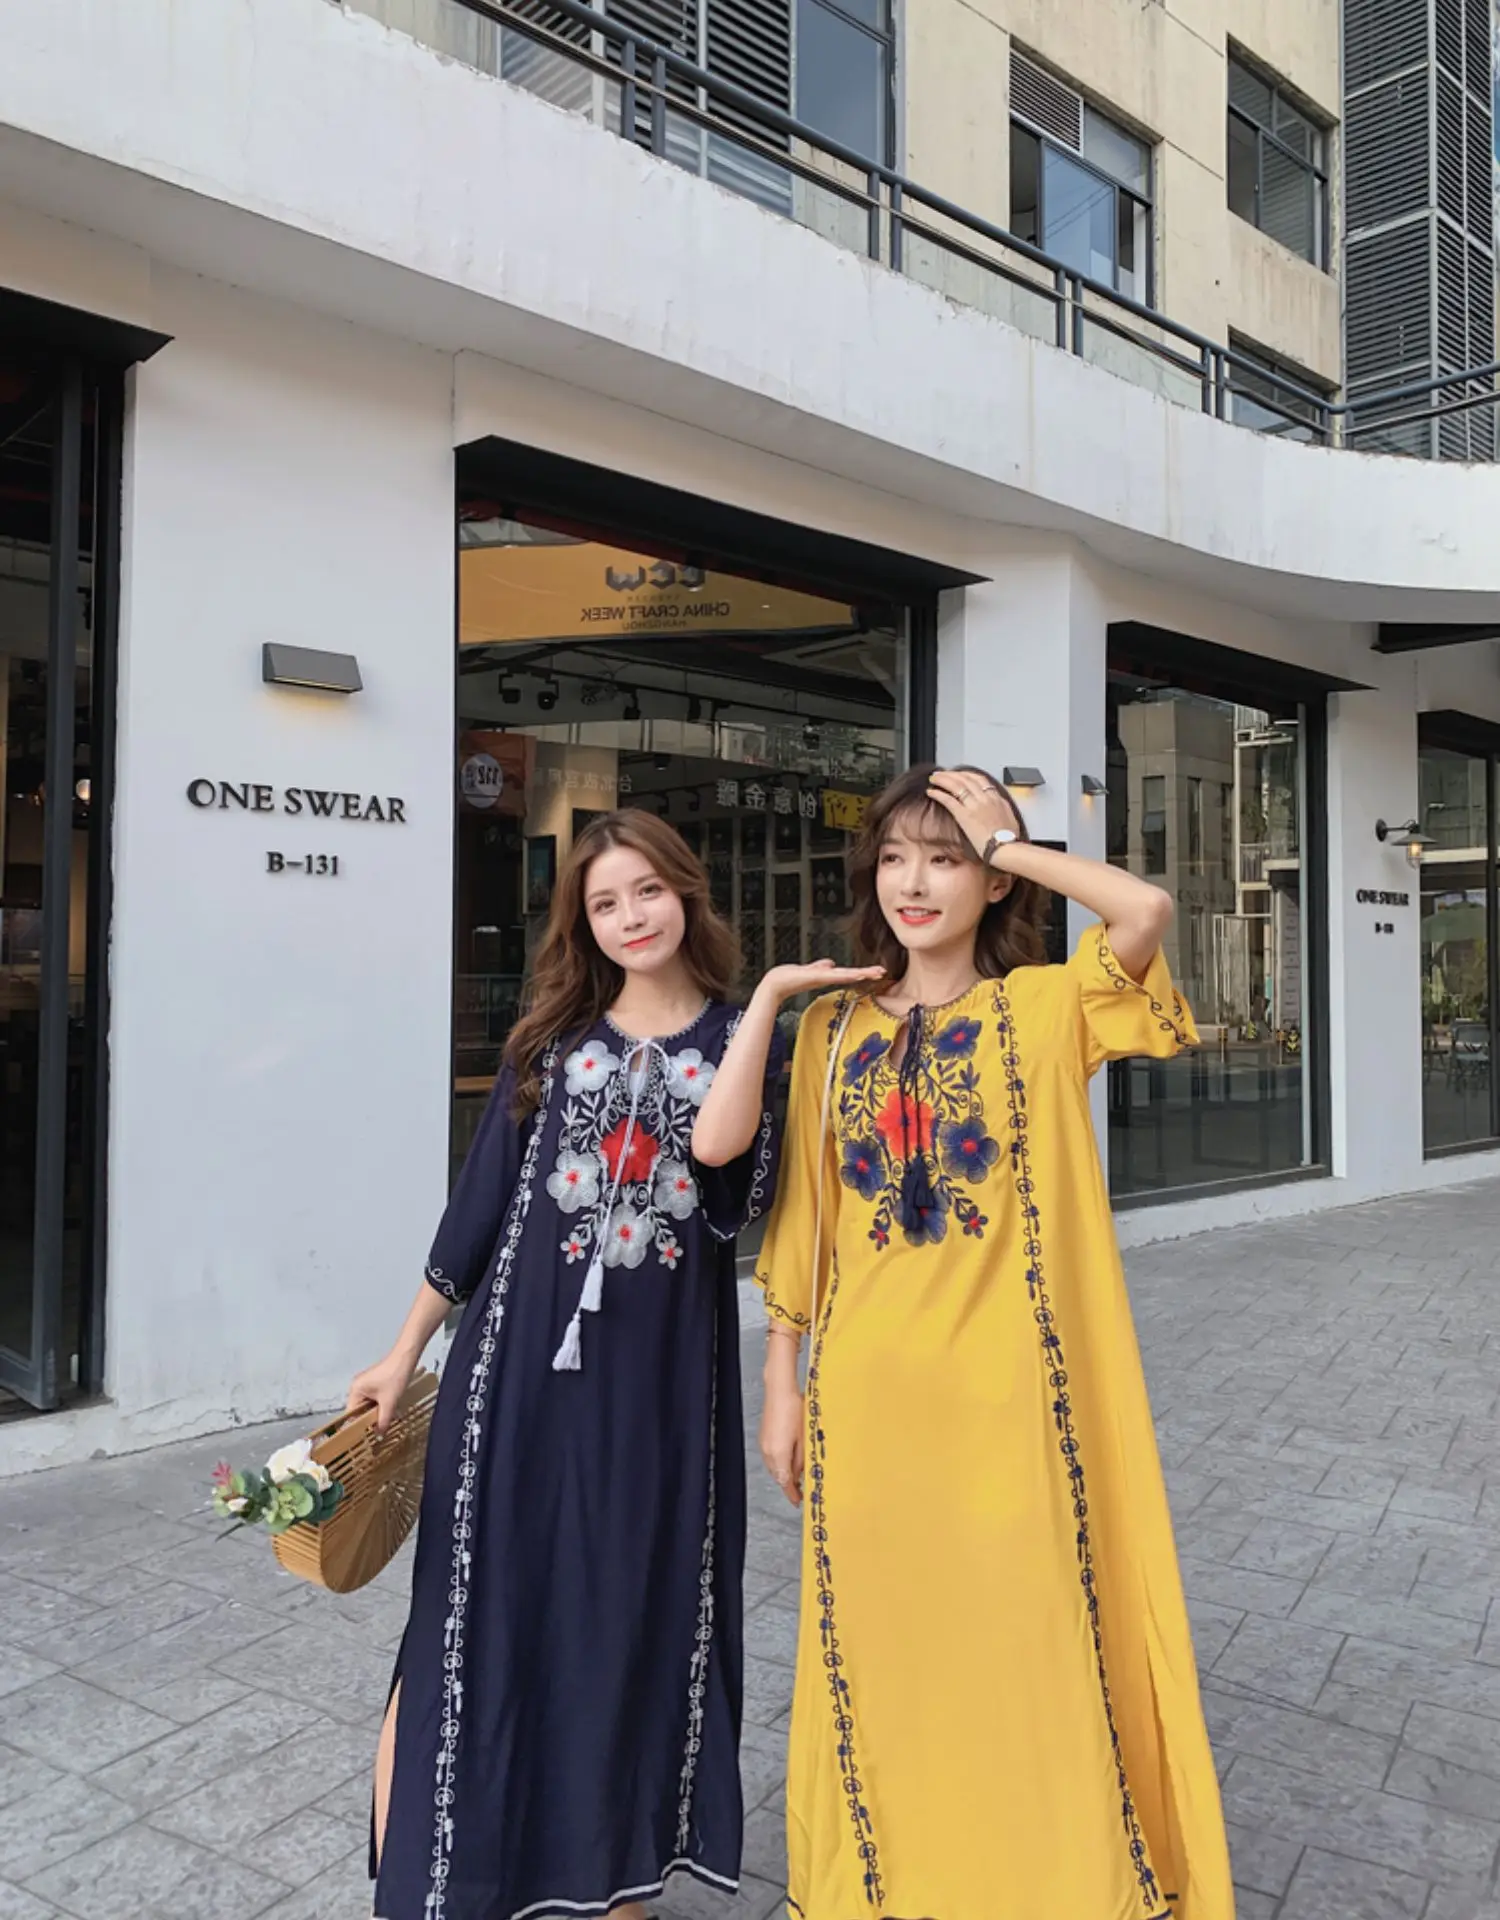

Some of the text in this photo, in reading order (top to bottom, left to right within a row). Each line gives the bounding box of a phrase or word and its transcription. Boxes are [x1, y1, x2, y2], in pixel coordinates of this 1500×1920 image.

[187, 778, 407, 823] ONE SWEAR
[266, 851, 339, 876] B-131
[1356, 889, 1378, 904] ONE
